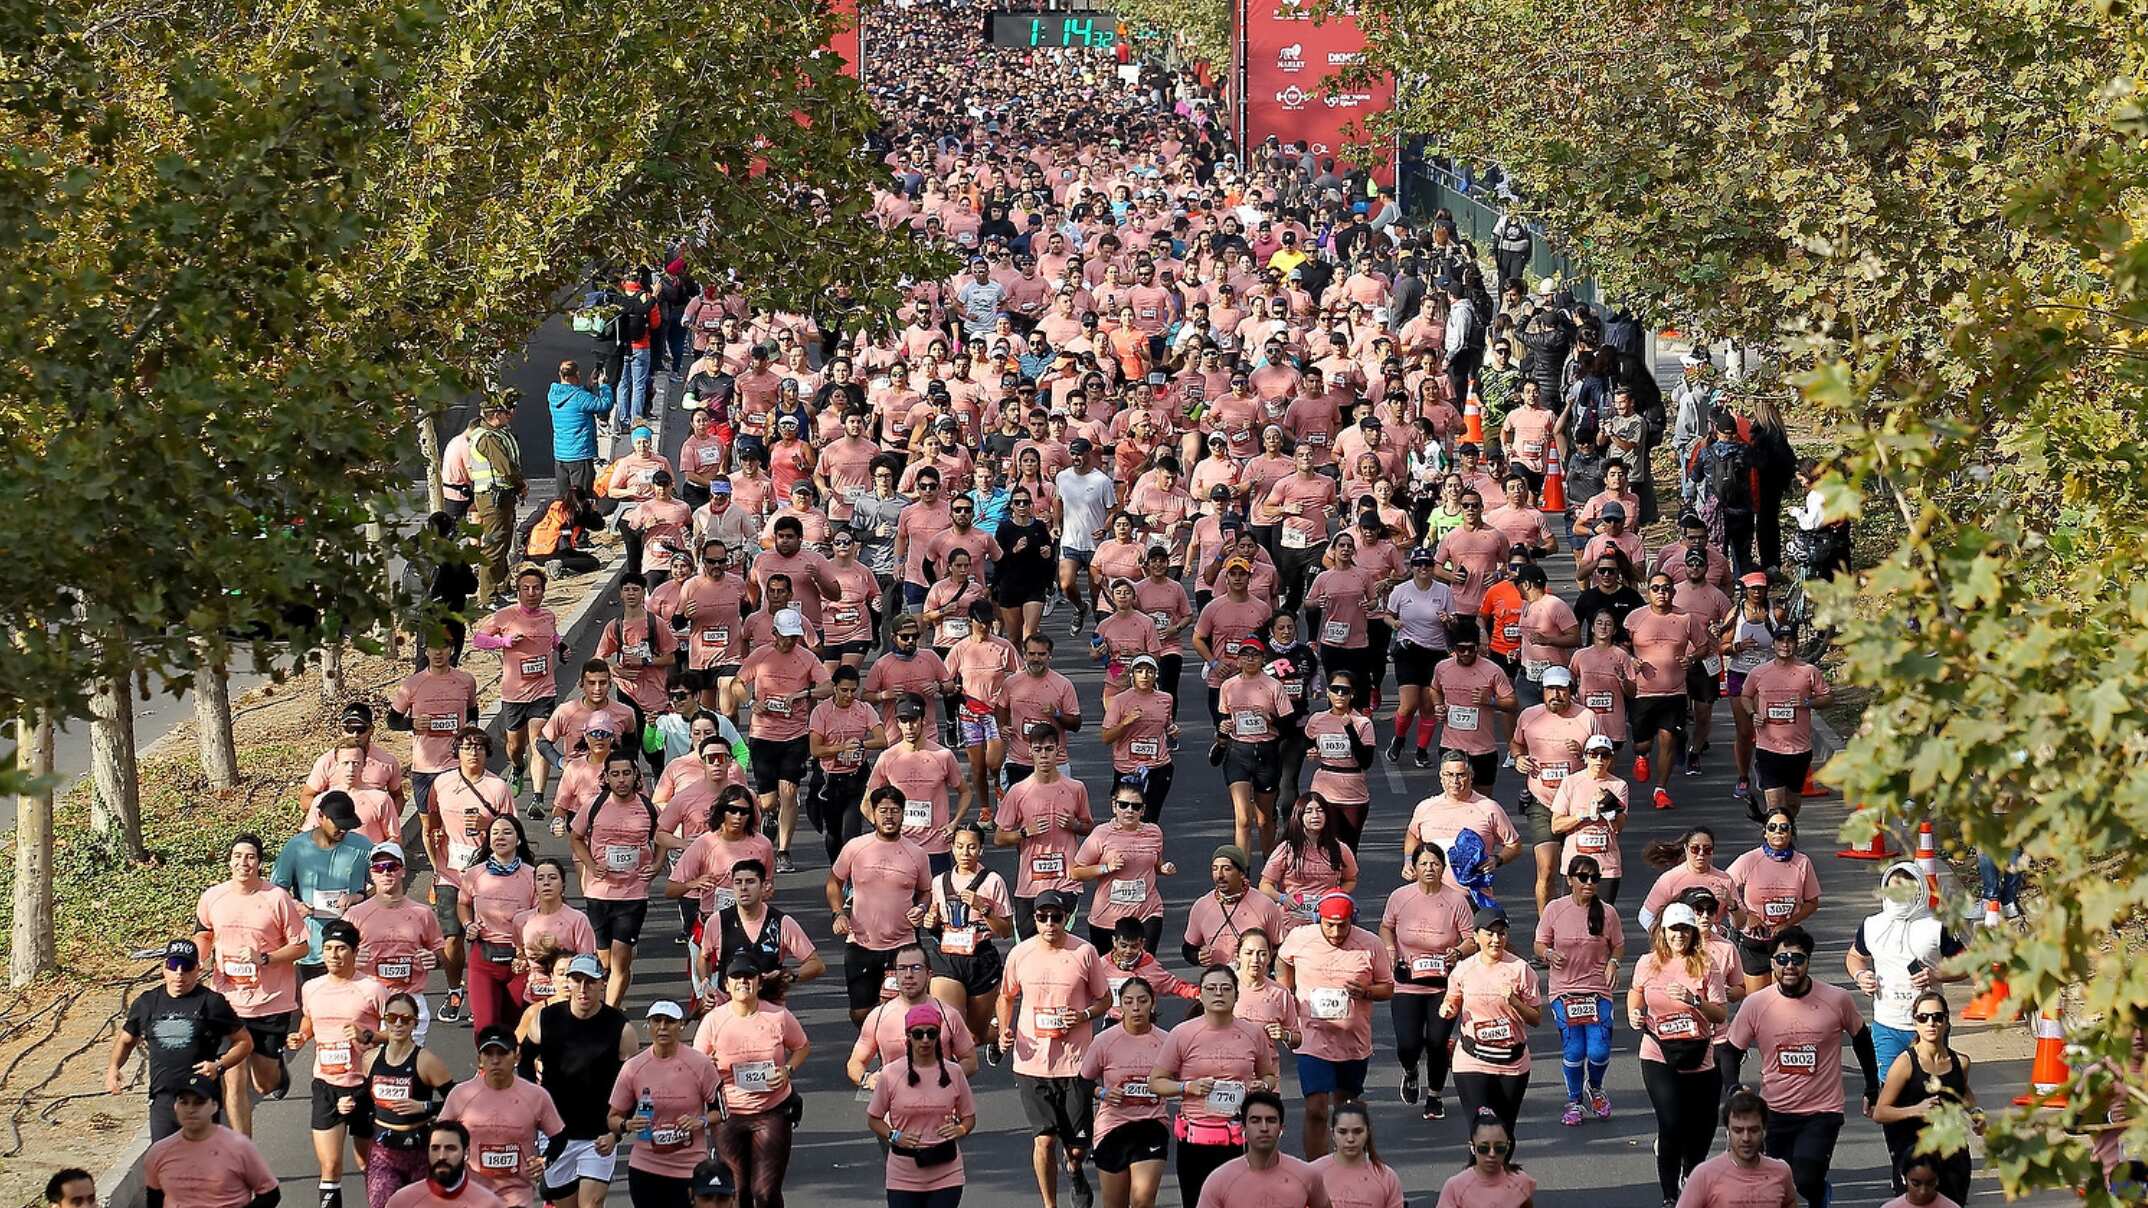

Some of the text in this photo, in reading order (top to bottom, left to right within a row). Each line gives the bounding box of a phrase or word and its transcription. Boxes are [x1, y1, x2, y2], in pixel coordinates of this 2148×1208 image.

[1455, 713, 1471, 723] 377
[616, 854, 632, 863] 193
[1783, 1054, 1813, 1066] 3002
